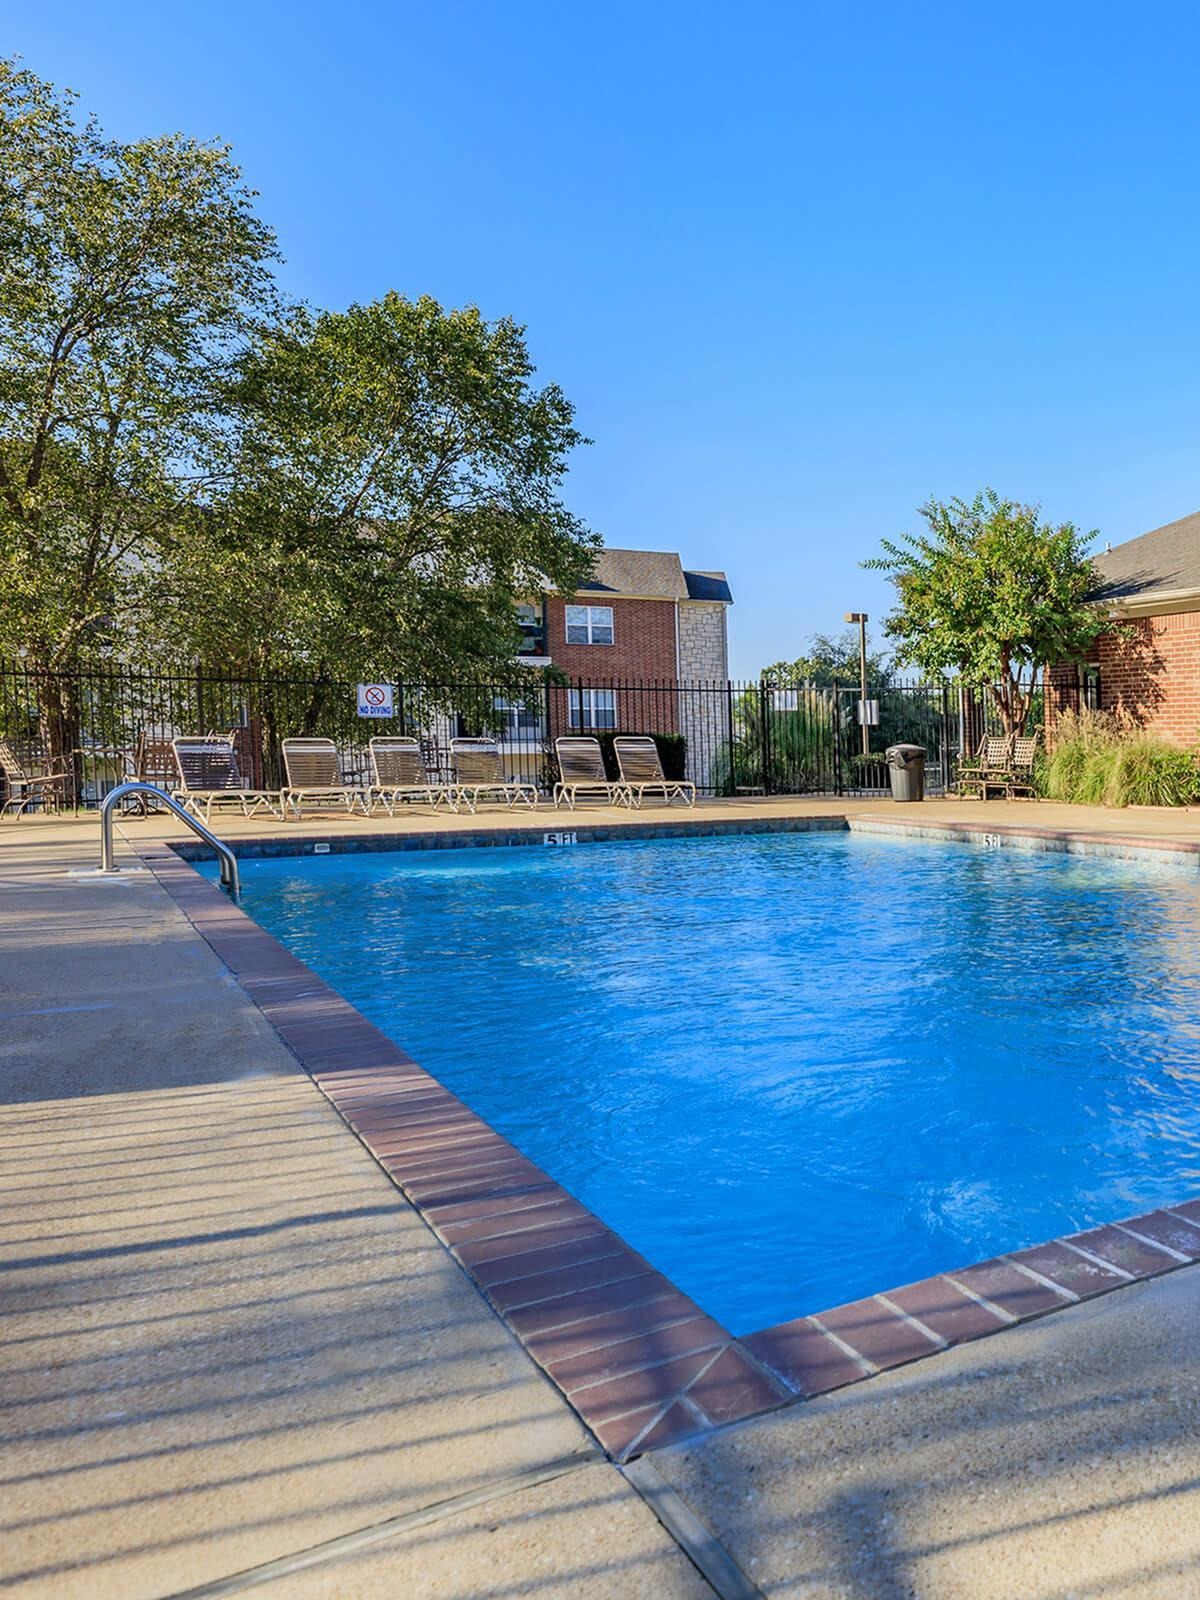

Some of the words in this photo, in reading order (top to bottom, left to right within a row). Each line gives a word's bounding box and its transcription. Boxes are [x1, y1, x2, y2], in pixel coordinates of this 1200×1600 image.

[360, 706, 368, 714] NO
[370, 706, 391, 714] DIVING
[547, 834, 557, 846] 5
[562, 832, 574, 845] FT
